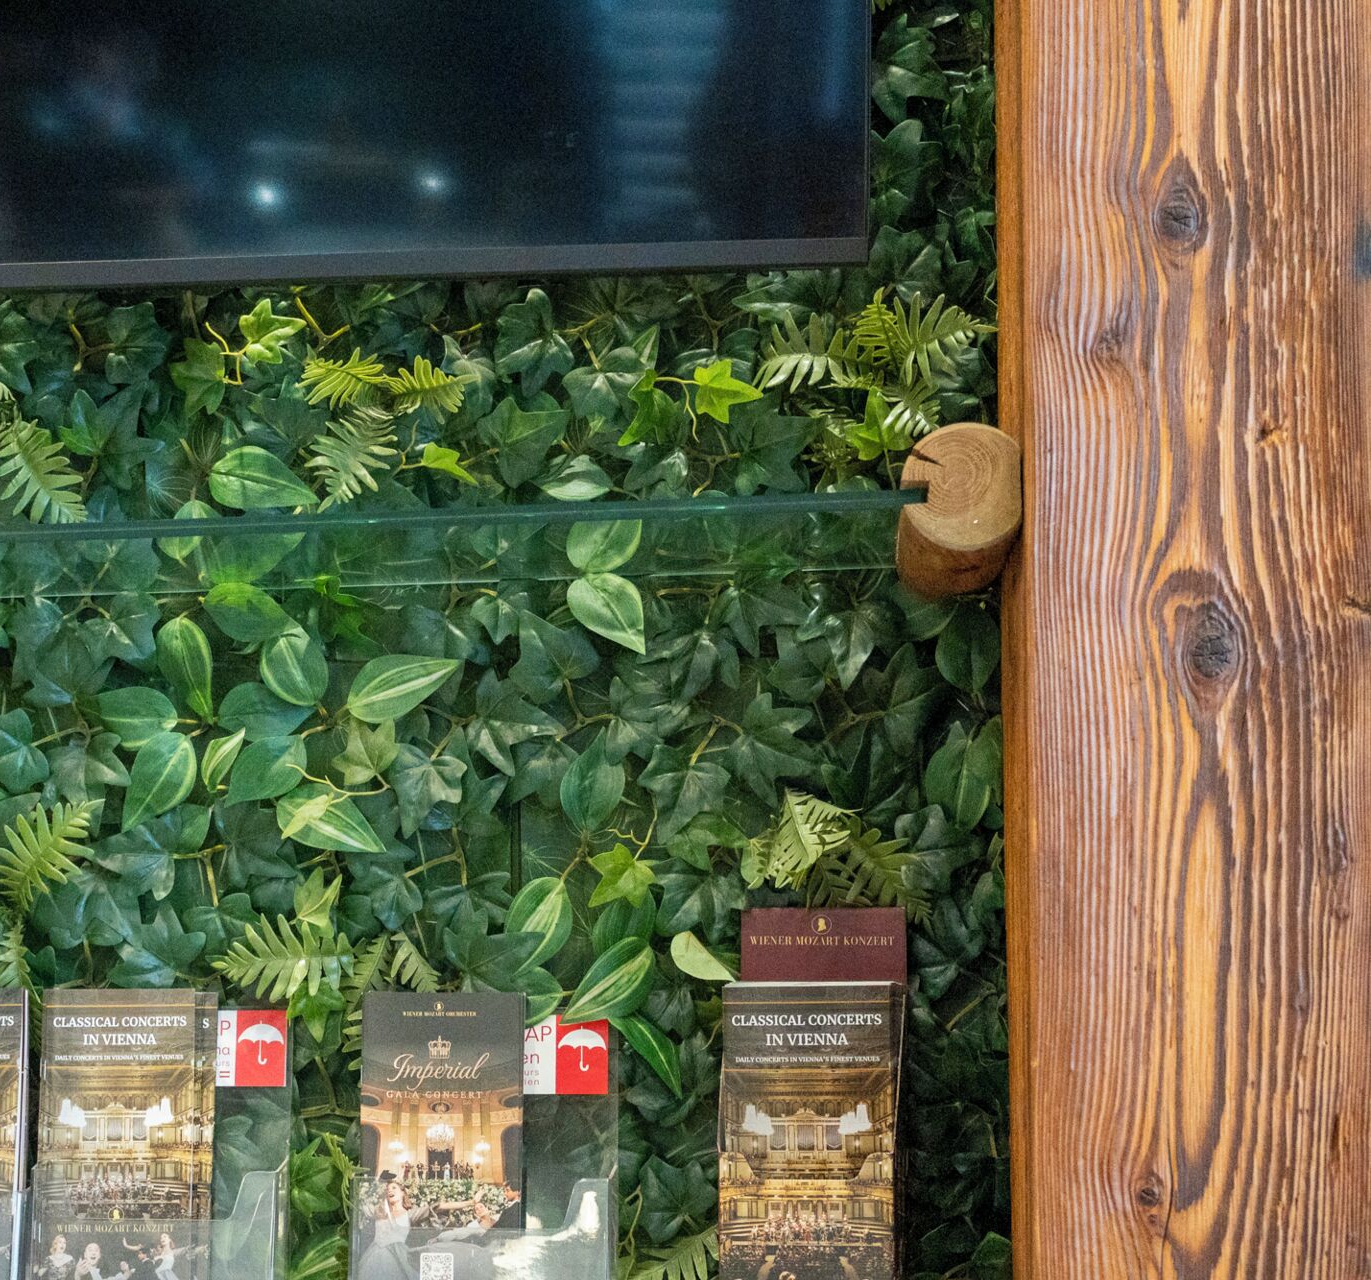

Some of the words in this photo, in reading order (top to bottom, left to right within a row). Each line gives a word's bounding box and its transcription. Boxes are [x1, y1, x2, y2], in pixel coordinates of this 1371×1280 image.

[750, 935, 792, 946] WIENER
[795, 935, 840, 946] MOZART
[843, 935, 895, 946] KONZERT
[53, 1016, 119, 1028] CLASSICAL
[121, 1015, 187, 1027] CONCERTS
[731, 1014, 806, 1026] CLASSICAL
[808, 1013, 882, 1025] CONCERTS
[83, 1034, 99, 1046] IN
[101, 1033, 157, 1046] VIENNA
[765, 1033, 784, 1046] IN
[786, 1033, 849, 1046] VIENNA
[386, 1052, 490, 1091] Imperial
[386, 1090, 419, 1099] GALA
[425, 1091, 483, 1099] CONCERT
[56, 1223, 91, 1233] WIENER
[94, 1223, 131, 1233] MOZART
[133, 1223, 175, 1233] KONZERT
